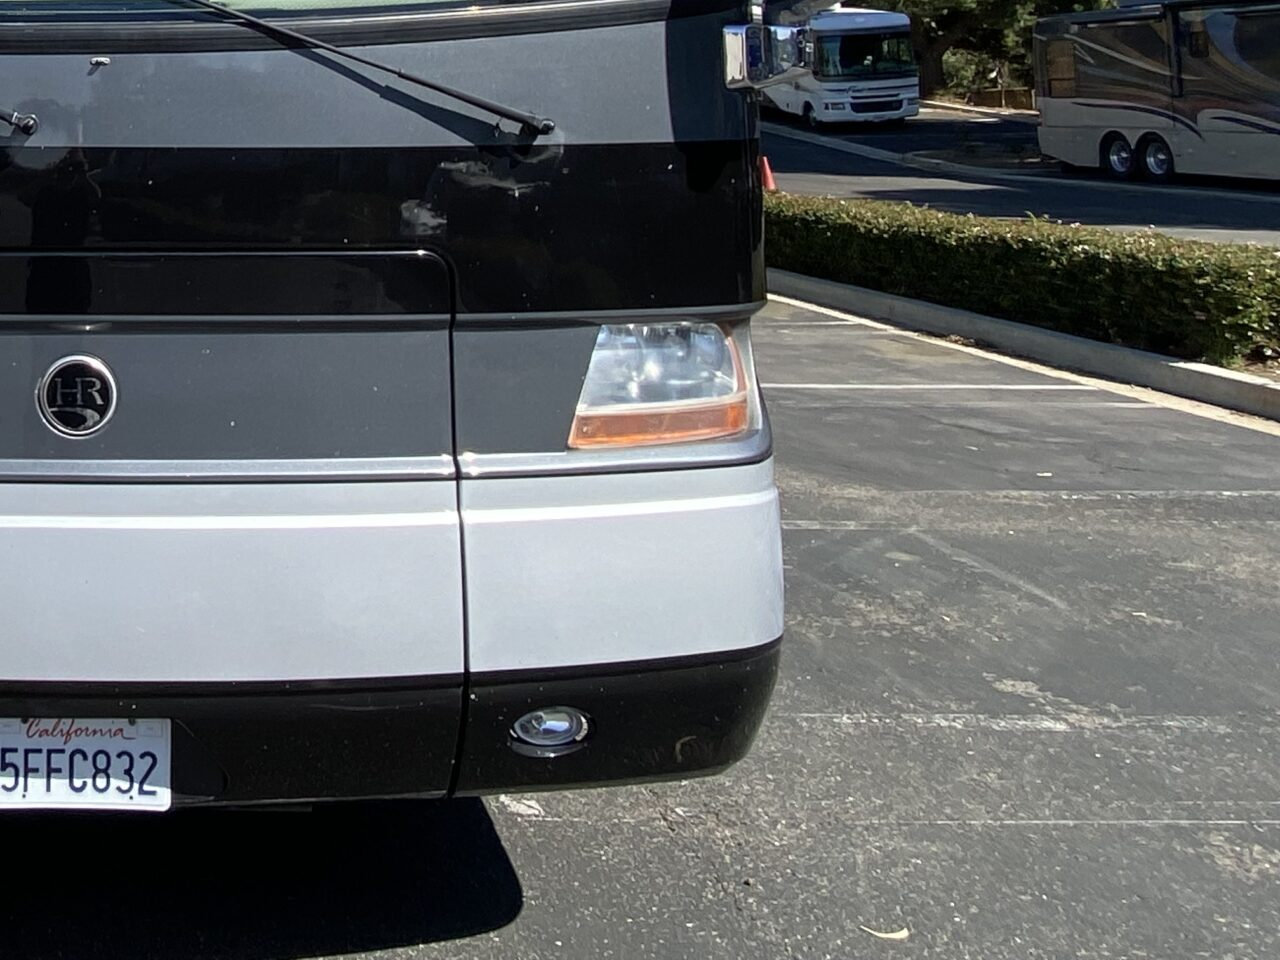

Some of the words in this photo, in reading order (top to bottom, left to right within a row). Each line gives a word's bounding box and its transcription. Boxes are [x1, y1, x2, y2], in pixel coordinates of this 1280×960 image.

[54, 377, 104, 405] HR
[26, 719, 136, 745] California
[0, 747, 158, 796] 5FFC832
